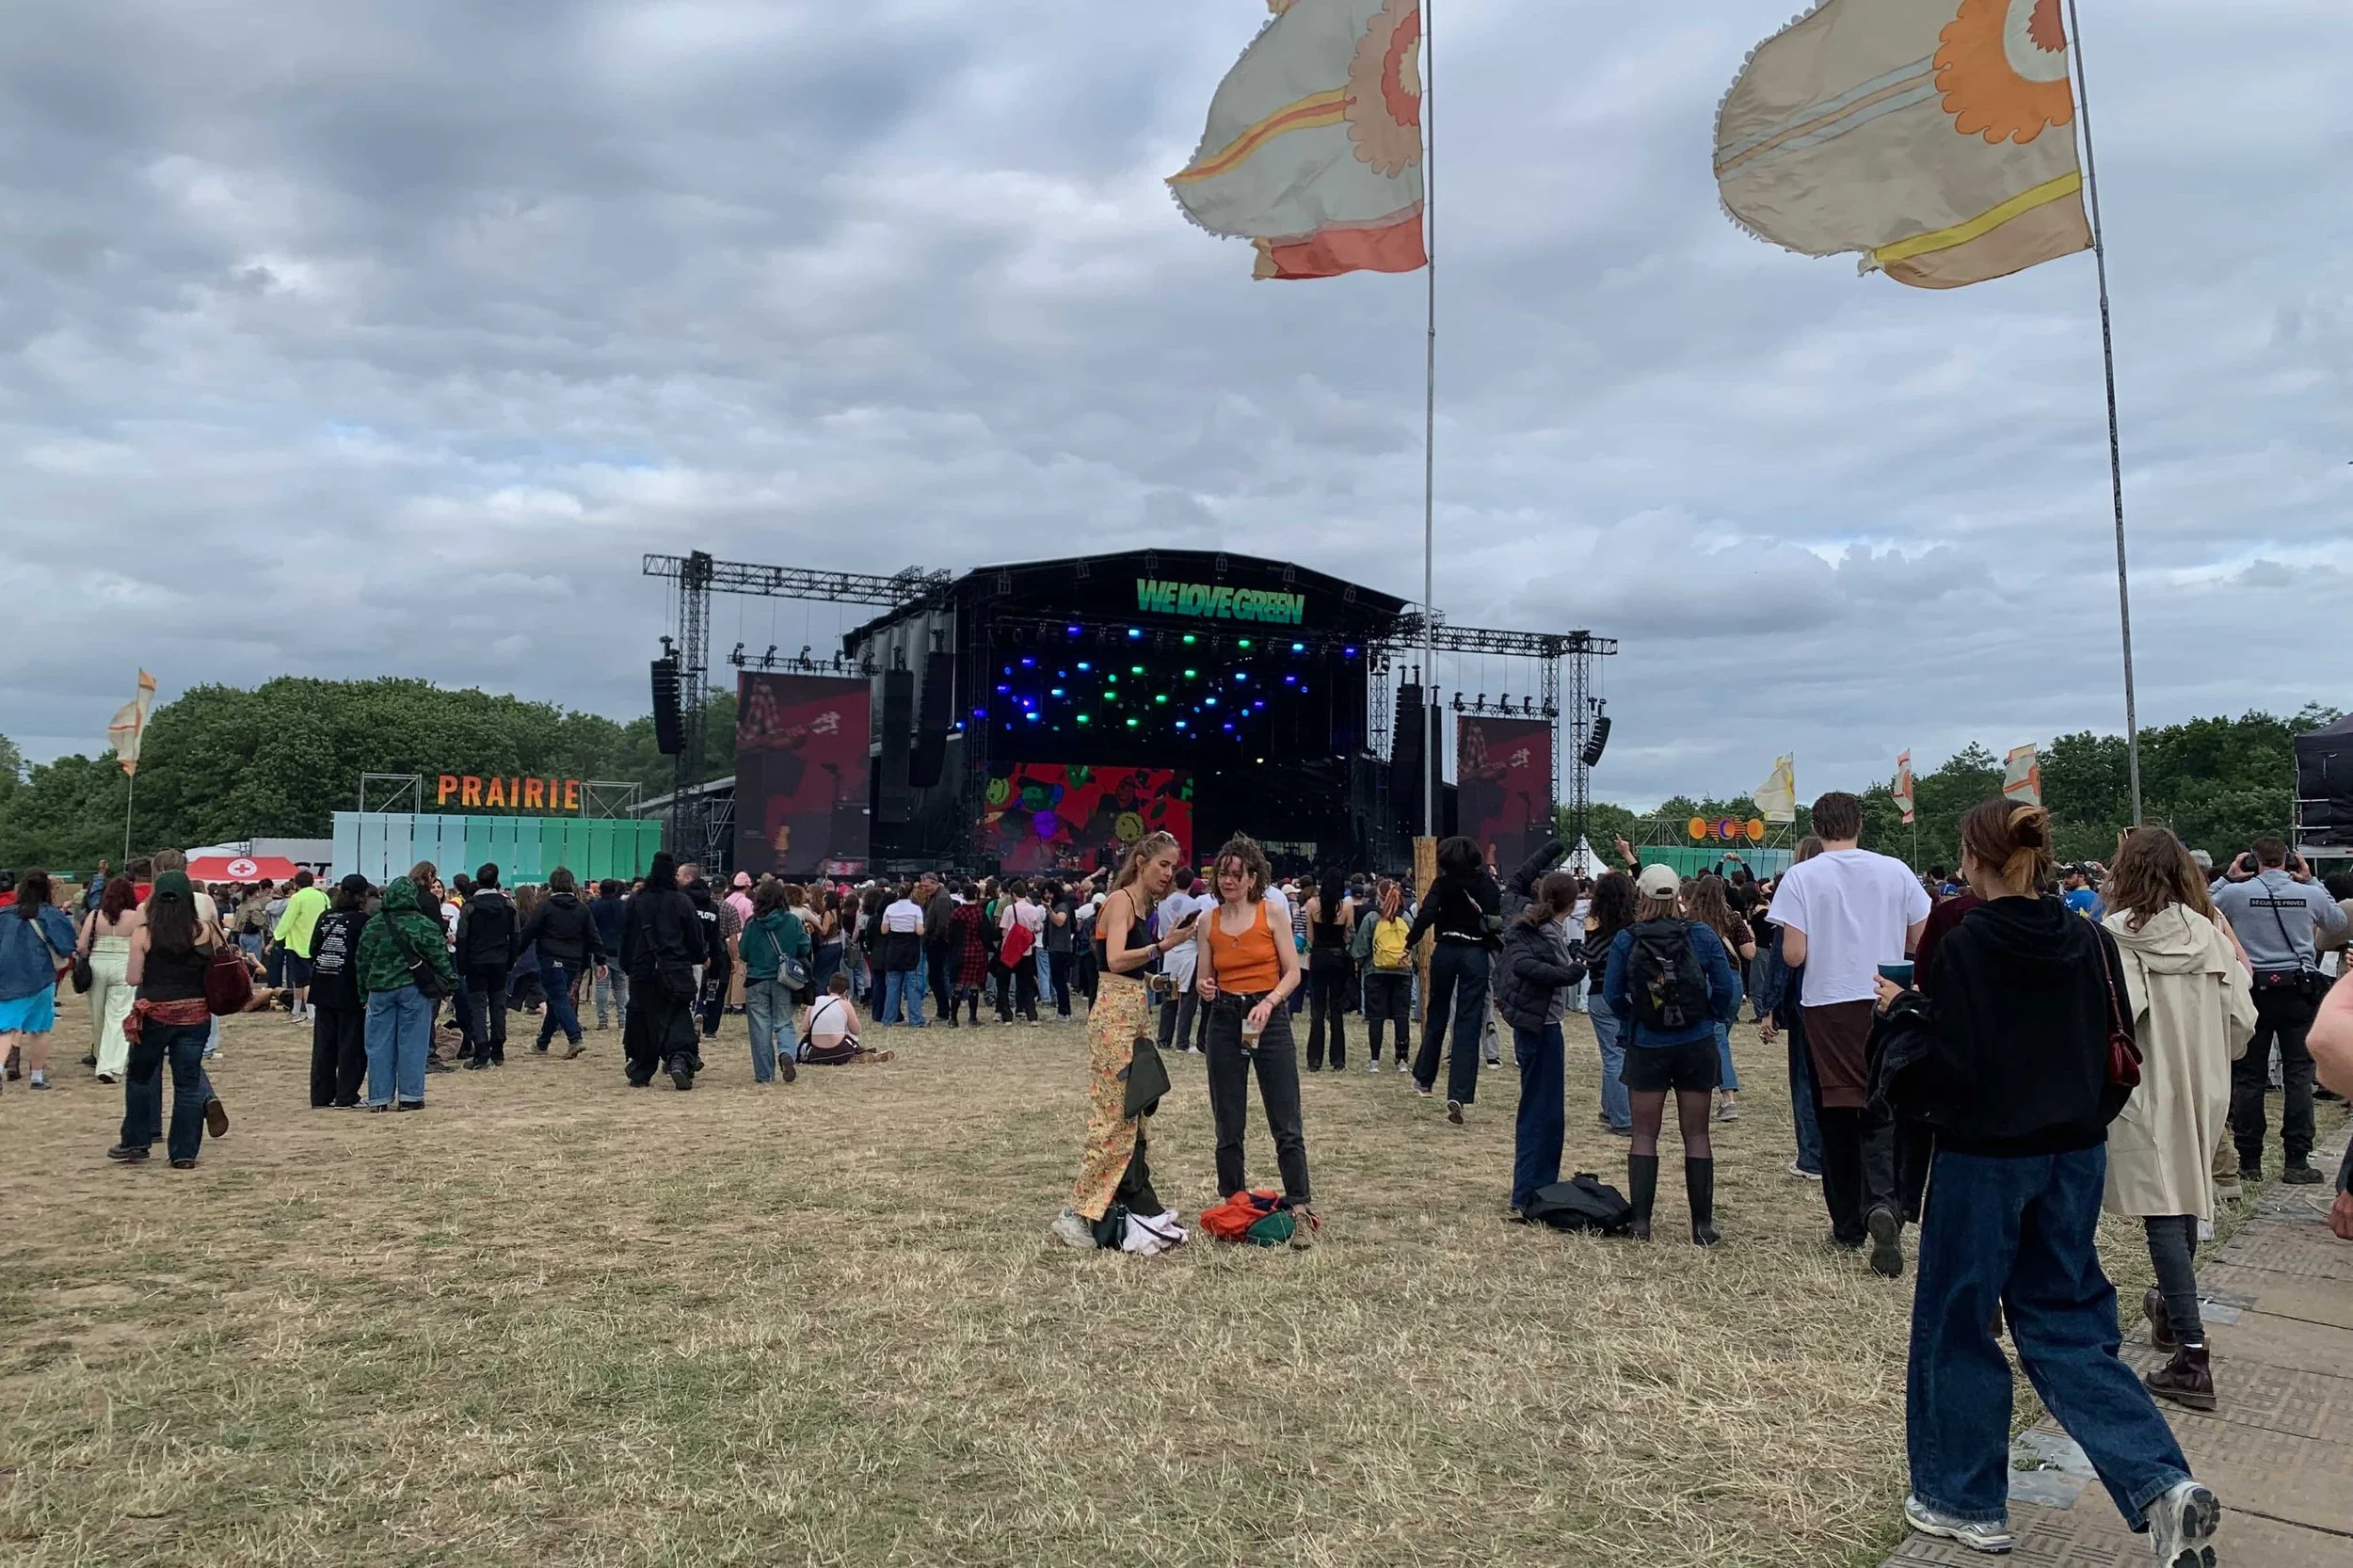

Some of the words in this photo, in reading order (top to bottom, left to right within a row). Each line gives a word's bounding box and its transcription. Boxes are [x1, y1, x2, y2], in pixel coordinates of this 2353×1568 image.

[1137, 579, 1177, 614] WE
[1177, 583, 1234, 618] LOVE
[1232, 588, 1305, 625] GREEN
[438, 775, 580, 809] PRAIRIE
